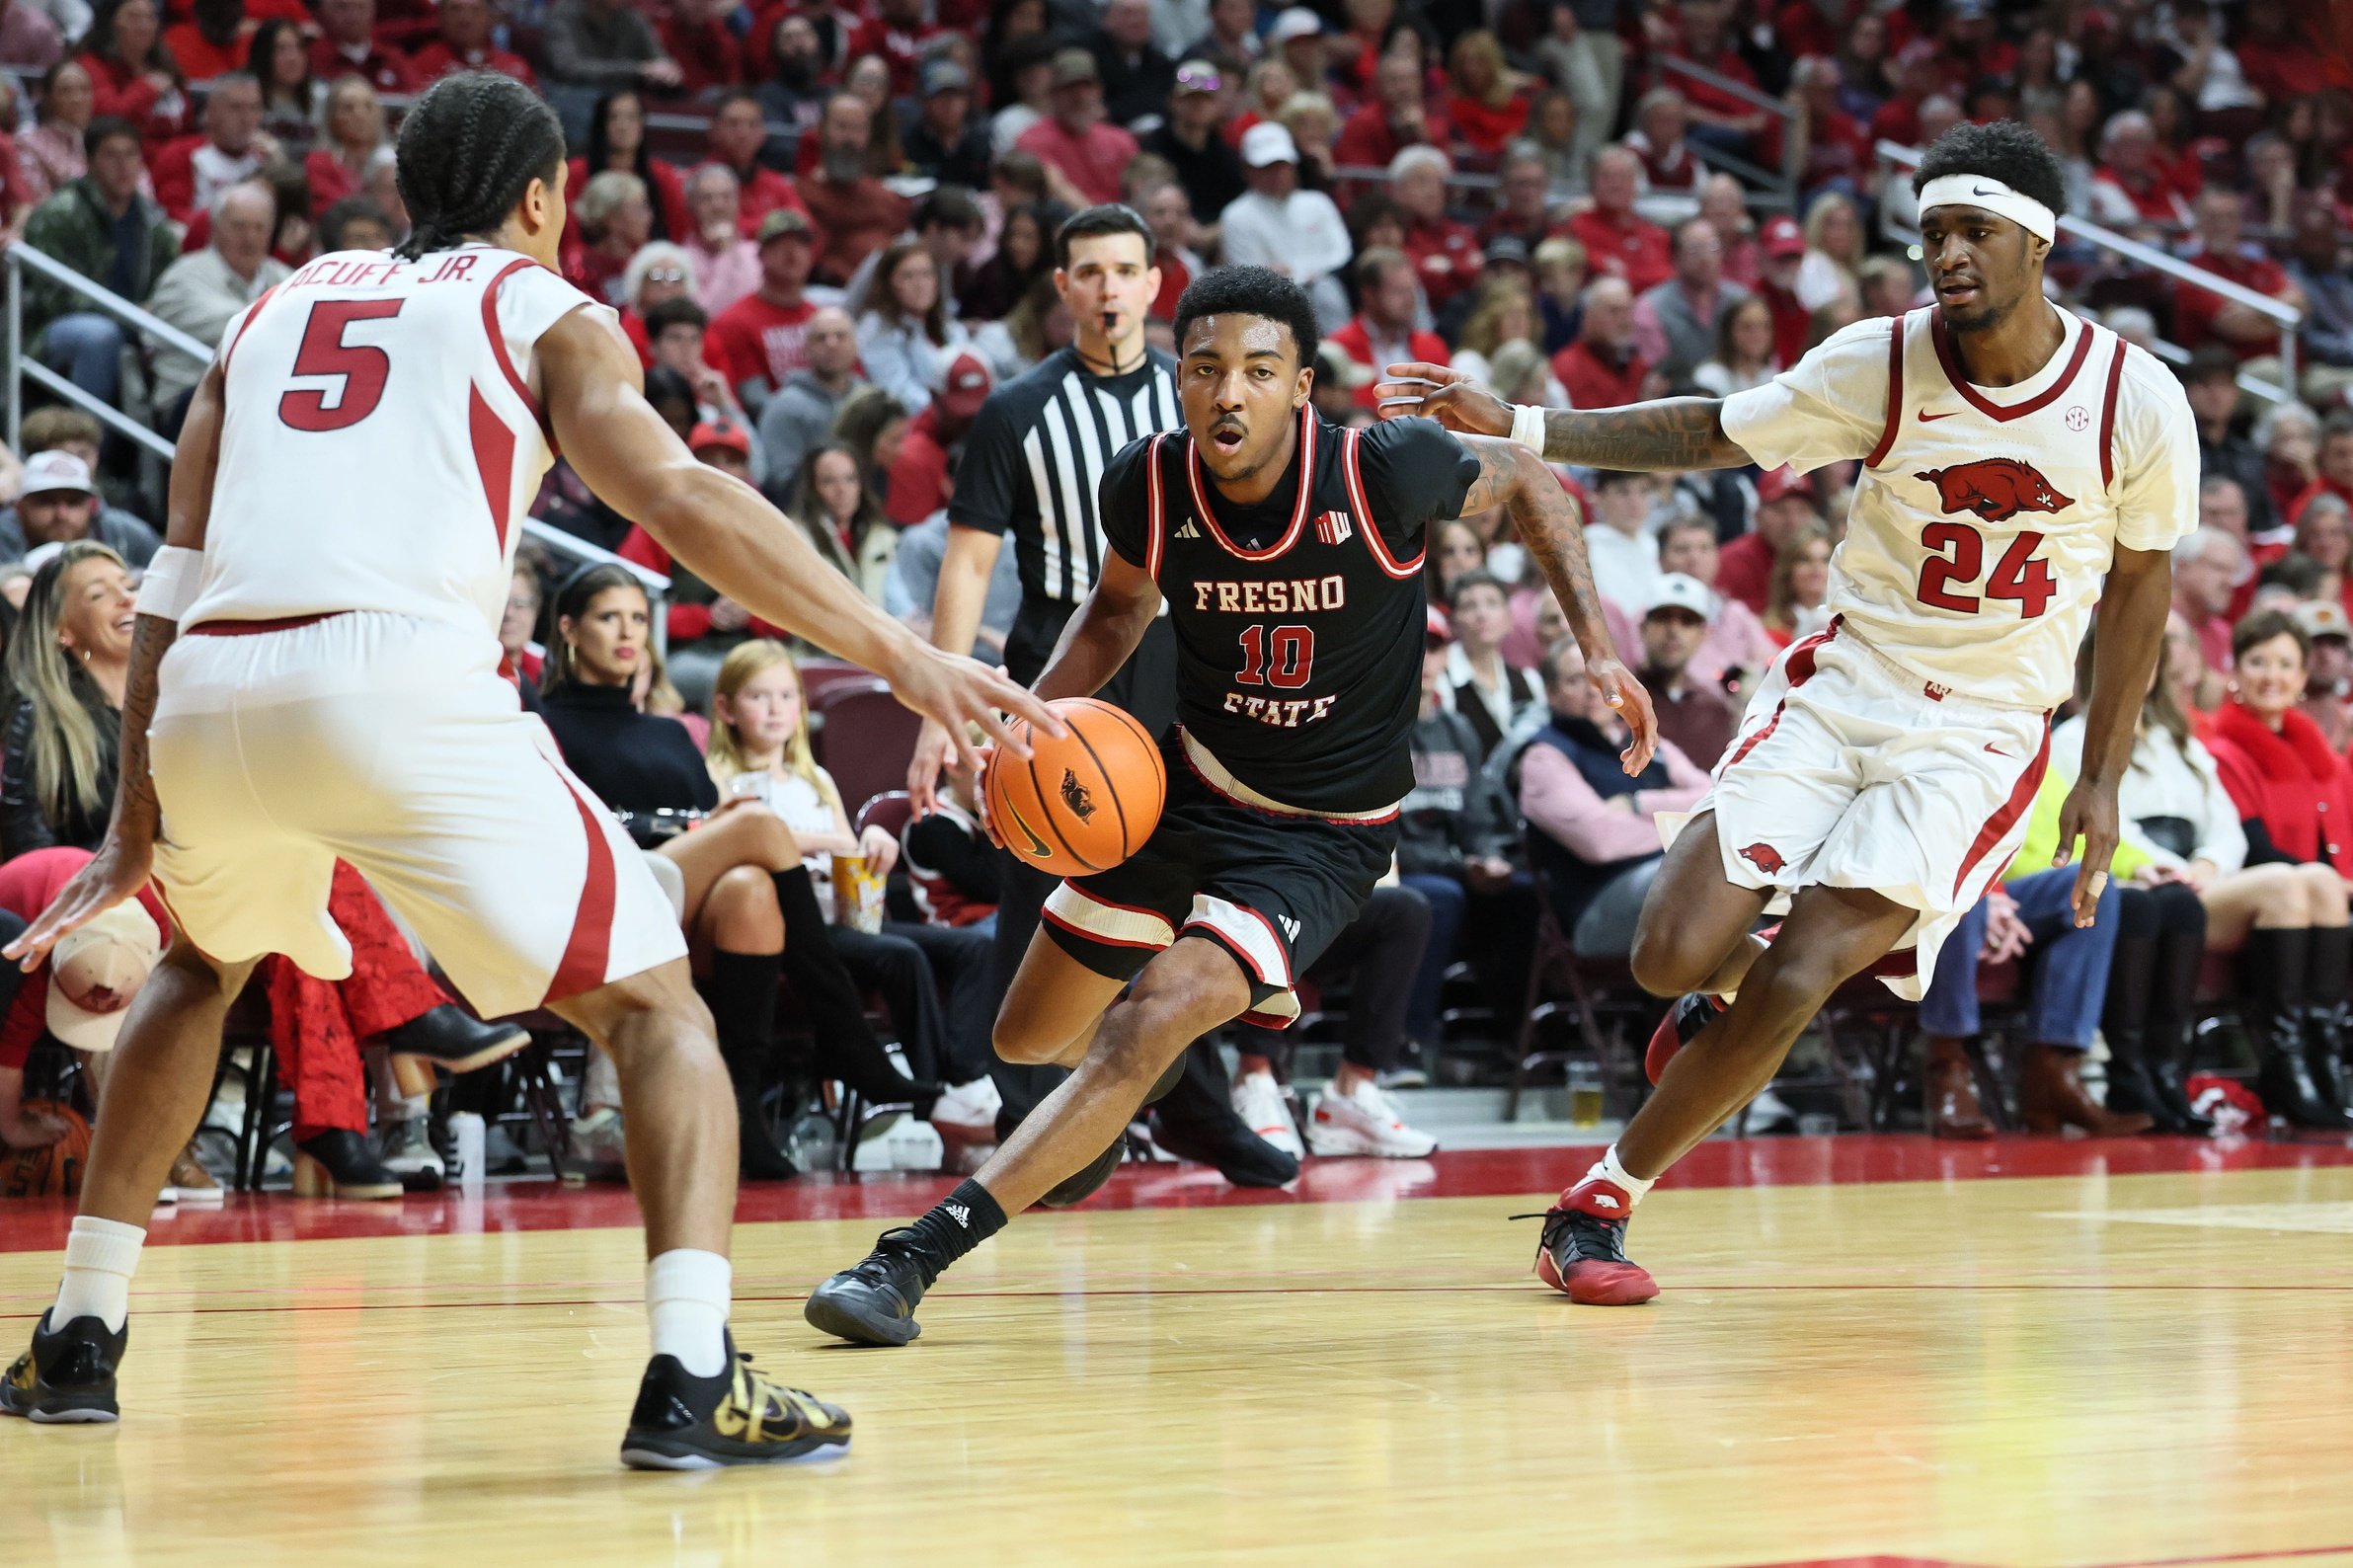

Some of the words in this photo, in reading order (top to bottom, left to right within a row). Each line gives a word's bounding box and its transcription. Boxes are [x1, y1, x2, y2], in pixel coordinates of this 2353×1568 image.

[417, 255, 479, 283] JR.
[278, 297, 408, 432] 5
[1193, 575, 1346, 613] FRESNO
[1917, 521, 2057, 619] 24
[1235, 624, 1314, 689] 10
[1222, 691, 1338, 729] STATE
